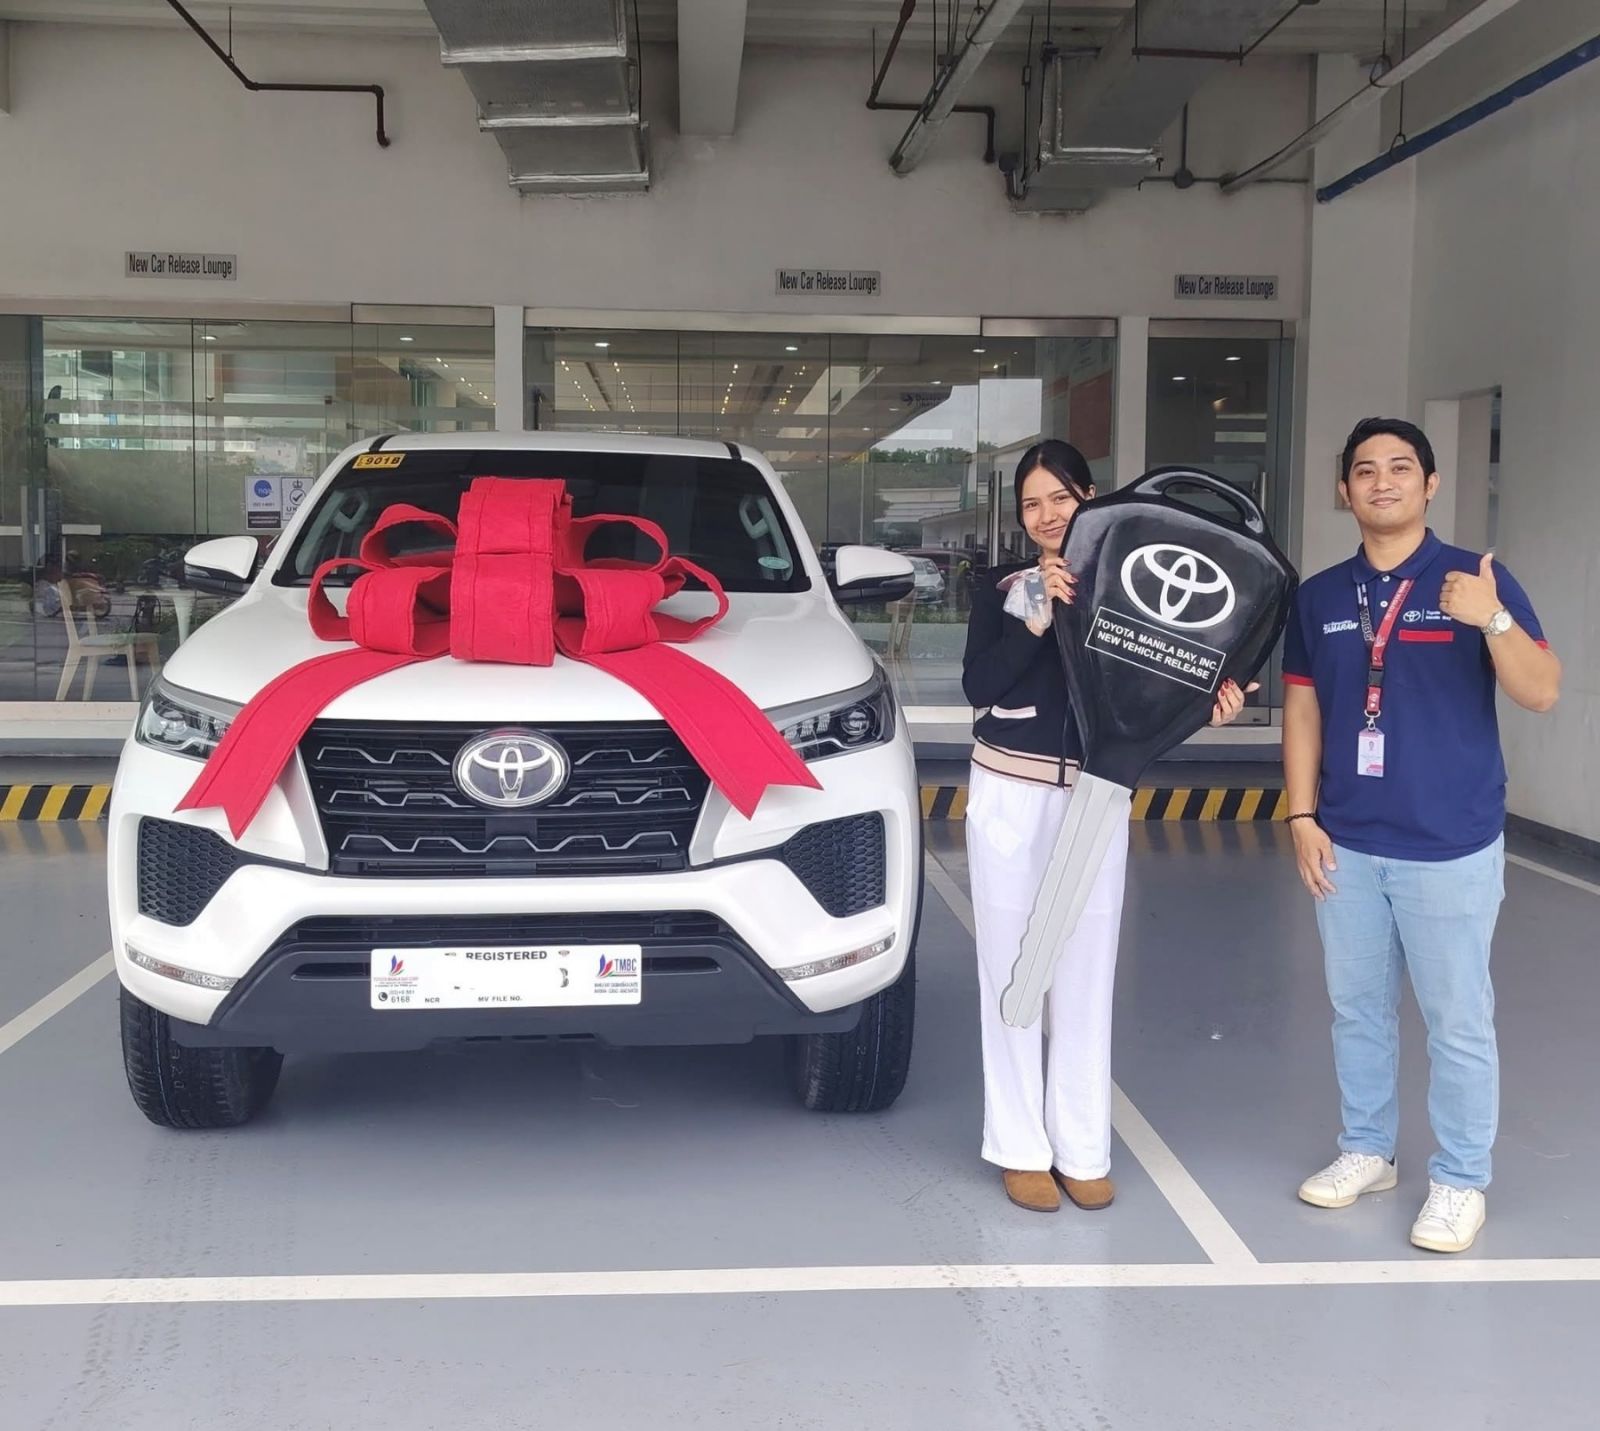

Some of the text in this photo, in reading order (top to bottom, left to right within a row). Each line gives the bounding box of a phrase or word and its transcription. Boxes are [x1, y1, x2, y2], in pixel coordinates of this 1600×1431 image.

[129, 253, 232, 278] New Car Release Lounge
[780, 271, 877, 294] New Car Release Lounge
[1178, 276, 1274, 300] New Car Release Lounge
[1097, 631, 1211, 680] NEW VEHICLE RELEASE
[1098, 618, 1218, 672] TOYOTA MANILA BAY, INC.
[465, 950, 548, 961] REGISTERED
[614, 958, 637, 972] TMBC
[478, 995, 490, 1003] MV
[491, 995, 508, 1003] FILE
